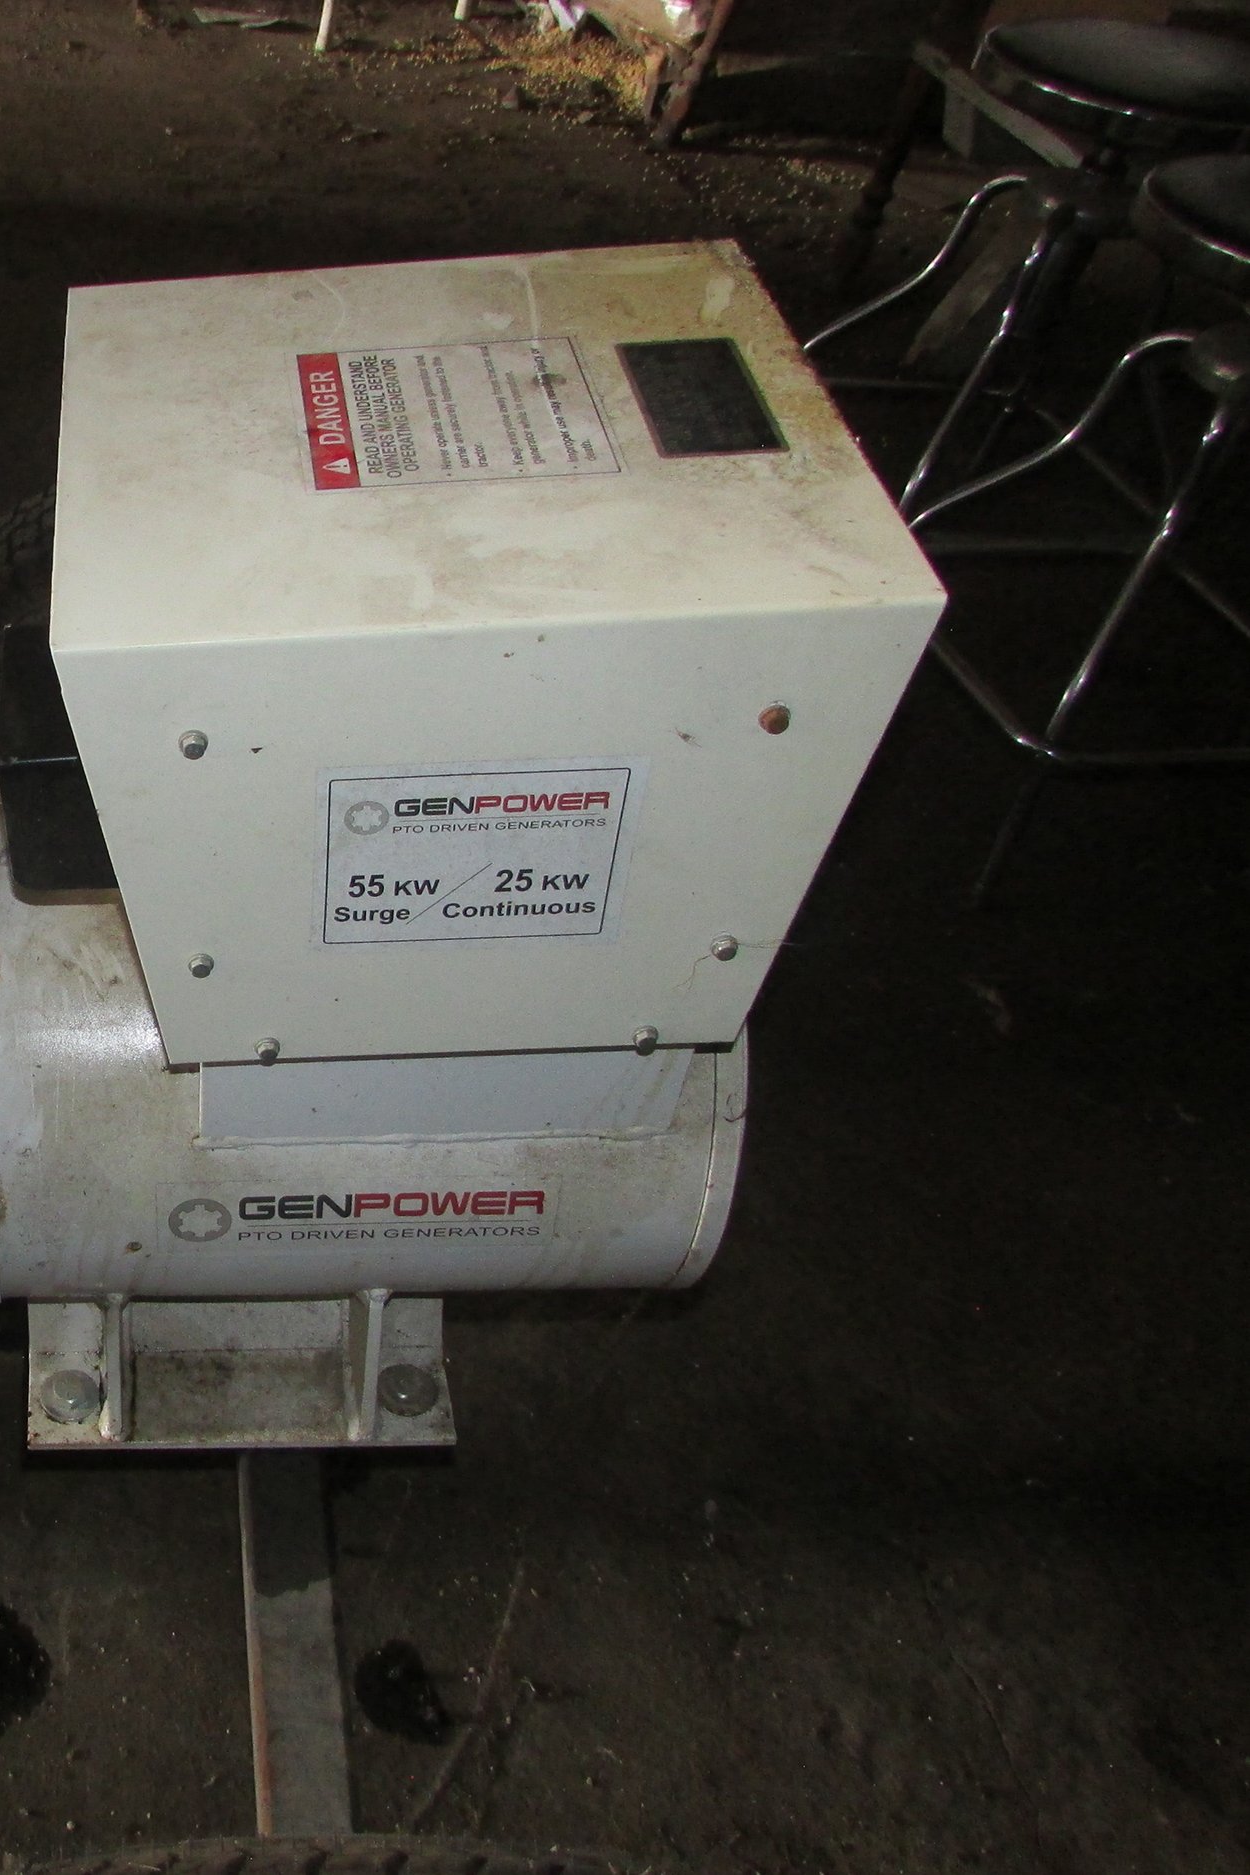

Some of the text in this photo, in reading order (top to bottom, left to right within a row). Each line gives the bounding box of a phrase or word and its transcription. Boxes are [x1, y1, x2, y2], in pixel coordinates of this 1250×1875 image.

[435, 367, 445, 375] to
[309, 370, 345, 445] DANGER
[363, 355, 402, 478] OWNERS MANUAL BEFORE
[381, 359, 419, 472] OPERATING GENERATOR
[427, 398, 440, 421] unless
[496, 397, 508, 413] away
[550, 401, 562, 415] may
[348, 361, 384, 474] READ AND UNDERSTAND
[445, 403, 461, 432] securely
[517, 411, 531, 429] while
[555, 416, 567, 429] use
[432, 421, 448, 448] operate
[453, 432, 464, 444] are
[502, 414, 518, 445] everyone
[456, 445, 470, 469] carrier
[511, 446, 524, 466] Keep
[524, 430, 545, 464] generator
[560, 430, 579, 463] Improper
[440, 449, 452, 470] Never
[393, 791, 610, 817] GENPOWER
[392, 818, 606, 834] PTO DRIVEN GENERATORS
[348, 874, 384, 897] 55
[495, 869, 533, 892] 25
[334, 906, 410, 924] Surge
[442, 900, 596, 918] Continuous
[238, 1191, 545, 1220] GENPOWER
[238, 1226, 540, 1241] PTO DRIVEN GENERATORS
